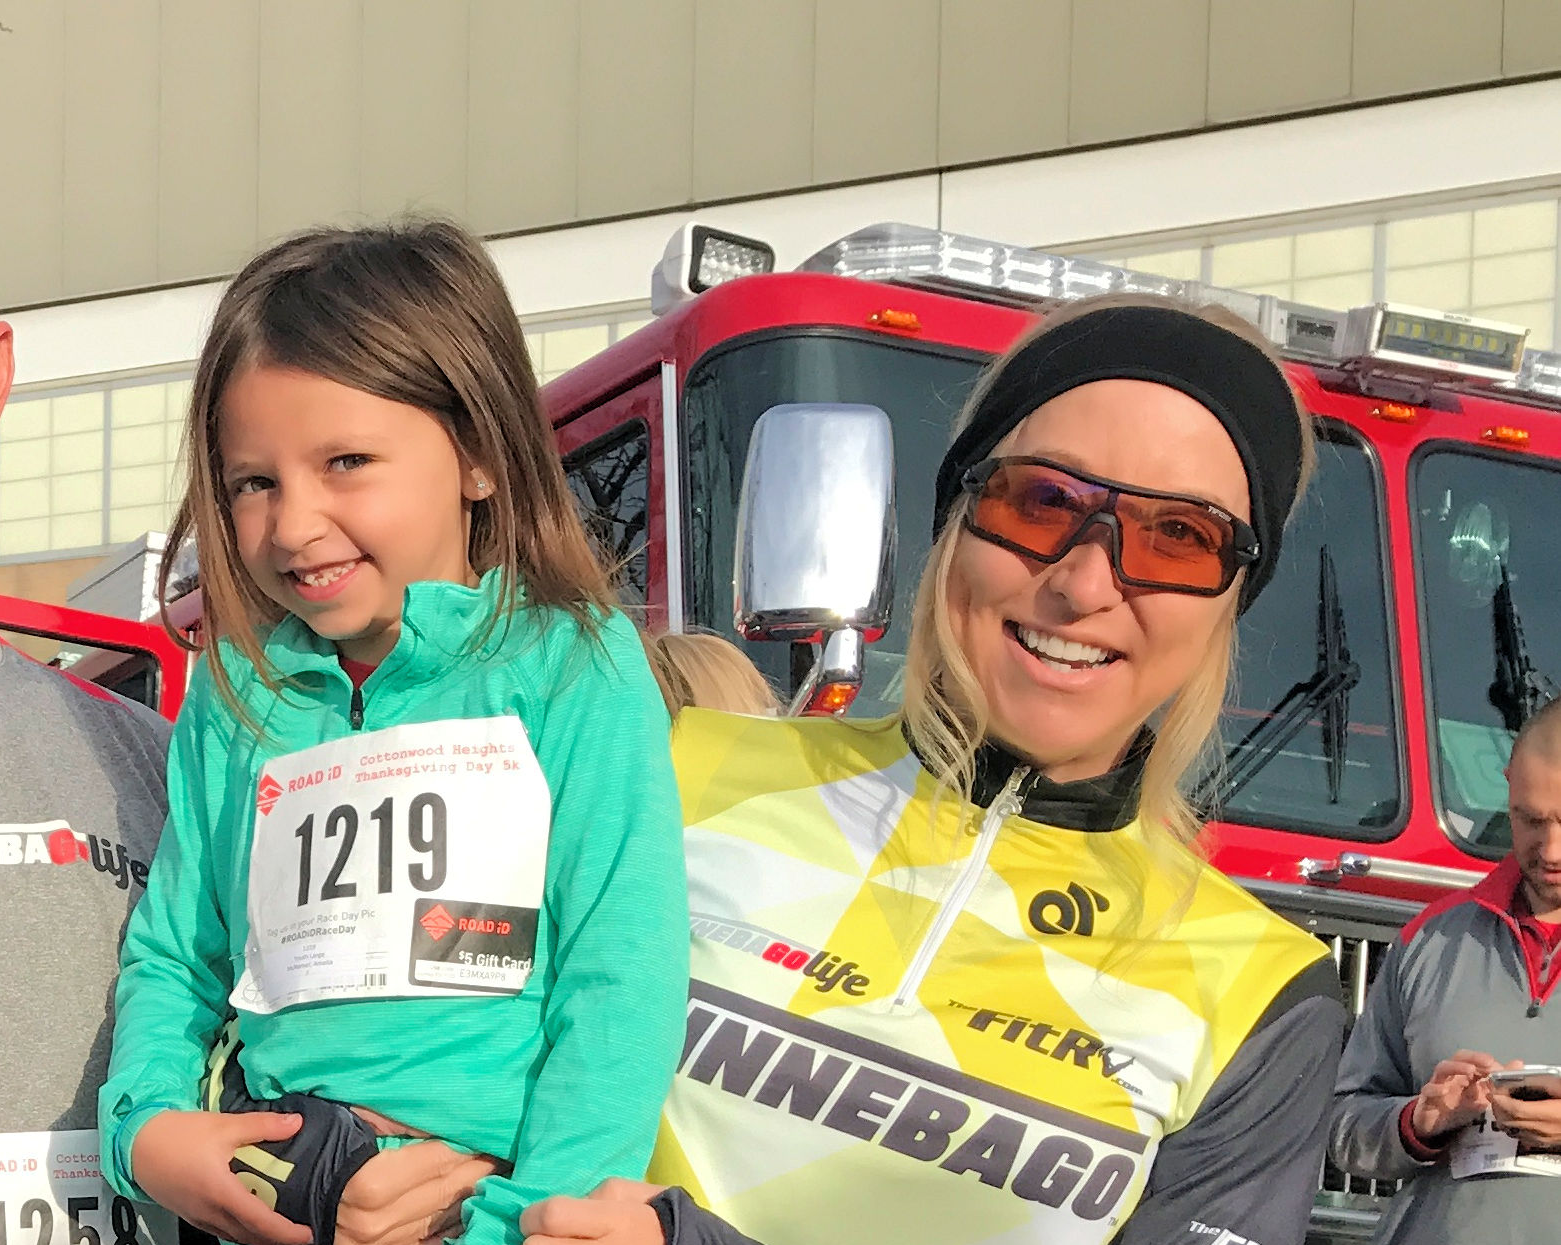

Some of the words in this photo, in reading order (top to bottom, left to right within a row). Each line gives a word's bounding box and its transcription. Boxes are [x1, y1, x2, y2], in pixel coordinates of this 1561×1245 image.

[360, 745, 444, 767] Cottonwood
[452, 742, 515, 757] Heights
[288, 770, 324, 793] ROAD
[327, 765, 343, 782] iD
[355, 762, 456, 783] Thanksgiving
[466, 761, 493, 774] Day
[503, 761, 521, 771] 5k
[295, 792, 447, 907] 1219
[317, 914, 338, 924] Race
[342, 912, 359, 921] Day
[361, 909, 376, 918] Pic
[458, 918, 494, 933] ROAD
[497, 921, 511, 935] iD
[458, 950, 473, 966] $5
[477, 953, 499, 967] Gift
[502, 956, 532, 971] Card
[676, 1005, 1137, 1221] INNEBAGO
[22, 1158, 38, 1172] iD
[1189, 1220, 1221, 1236] The
